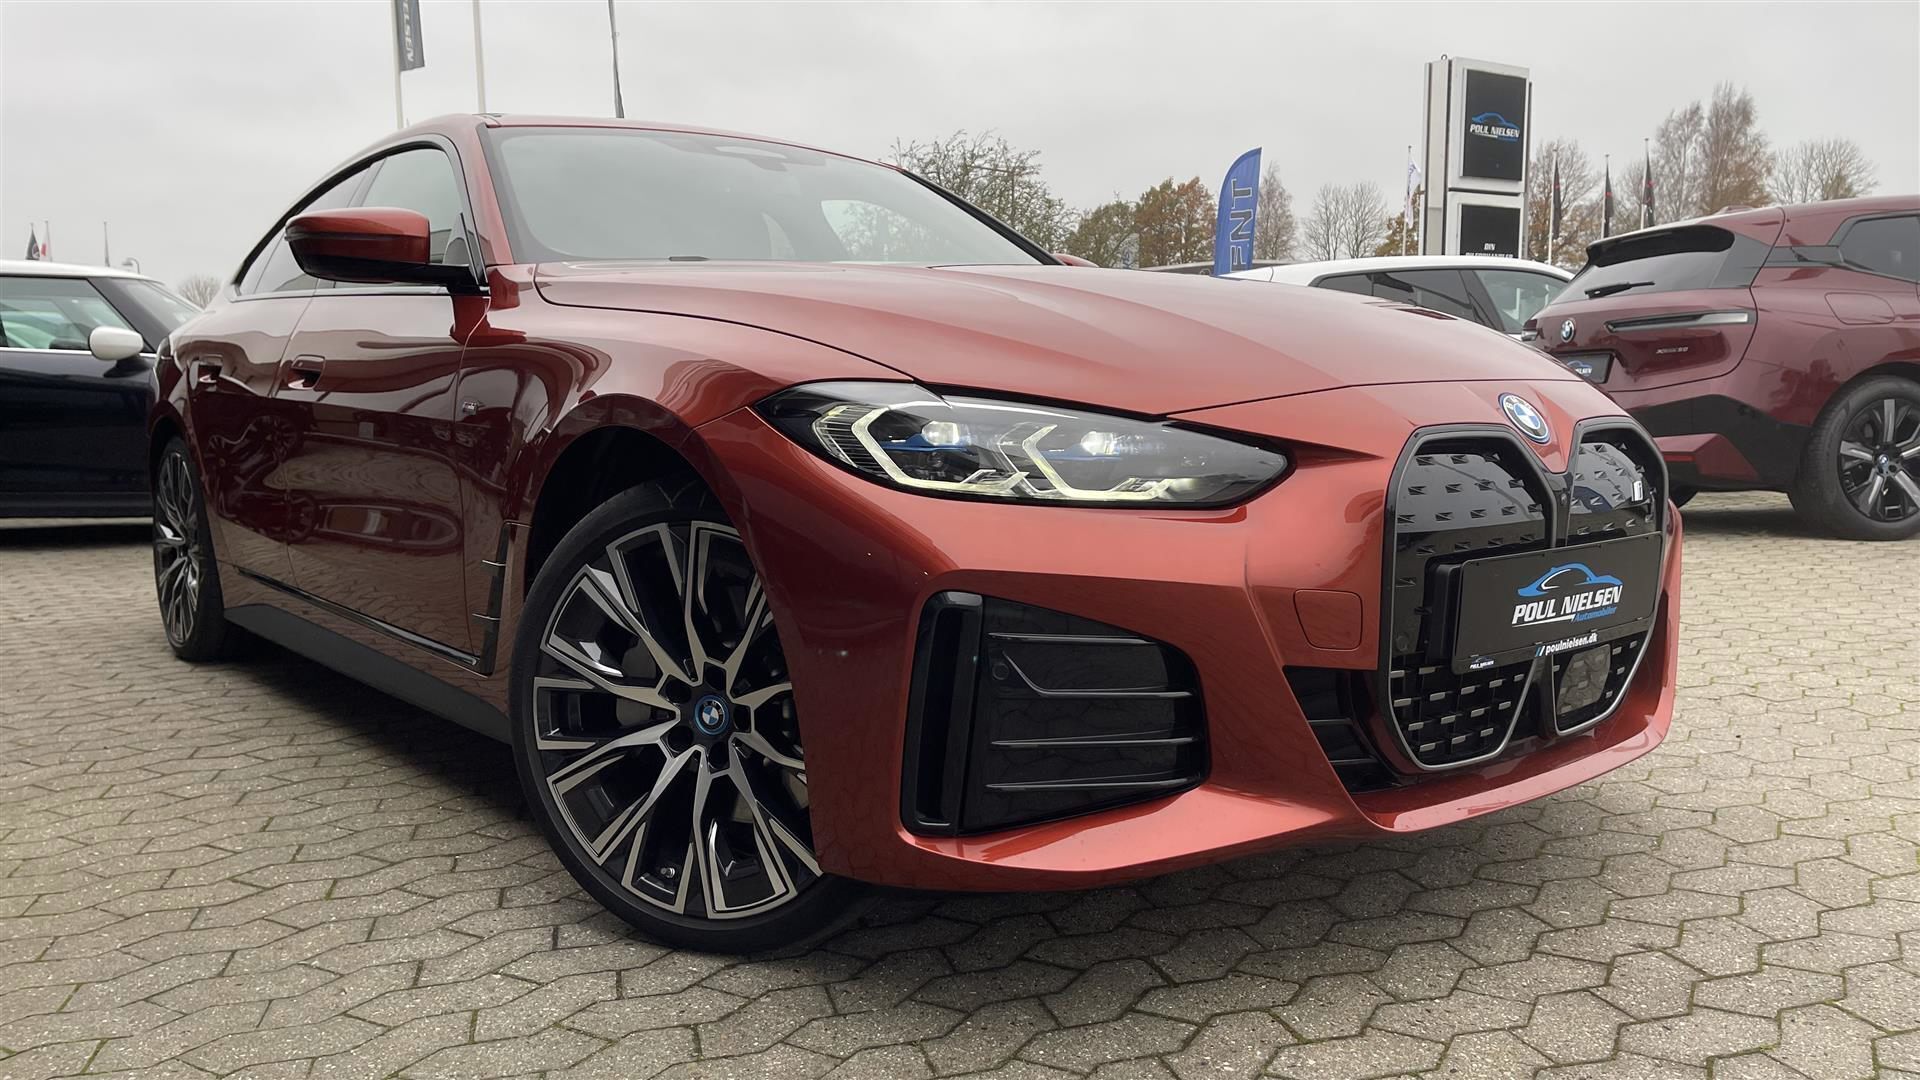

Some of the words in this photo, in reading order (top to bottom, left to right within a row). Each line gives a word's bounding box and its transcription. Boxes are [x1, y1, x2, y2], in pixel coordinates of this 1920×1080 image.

[403, 0, 414, 61] ELSEN
[1469, 123, 1490, 135] POUL
[1490, 126, 1521, 138] NIELSEN
[1511, 598, 1558, 625] POUL
[1560, 585, 1623, 615] NIELSEN
